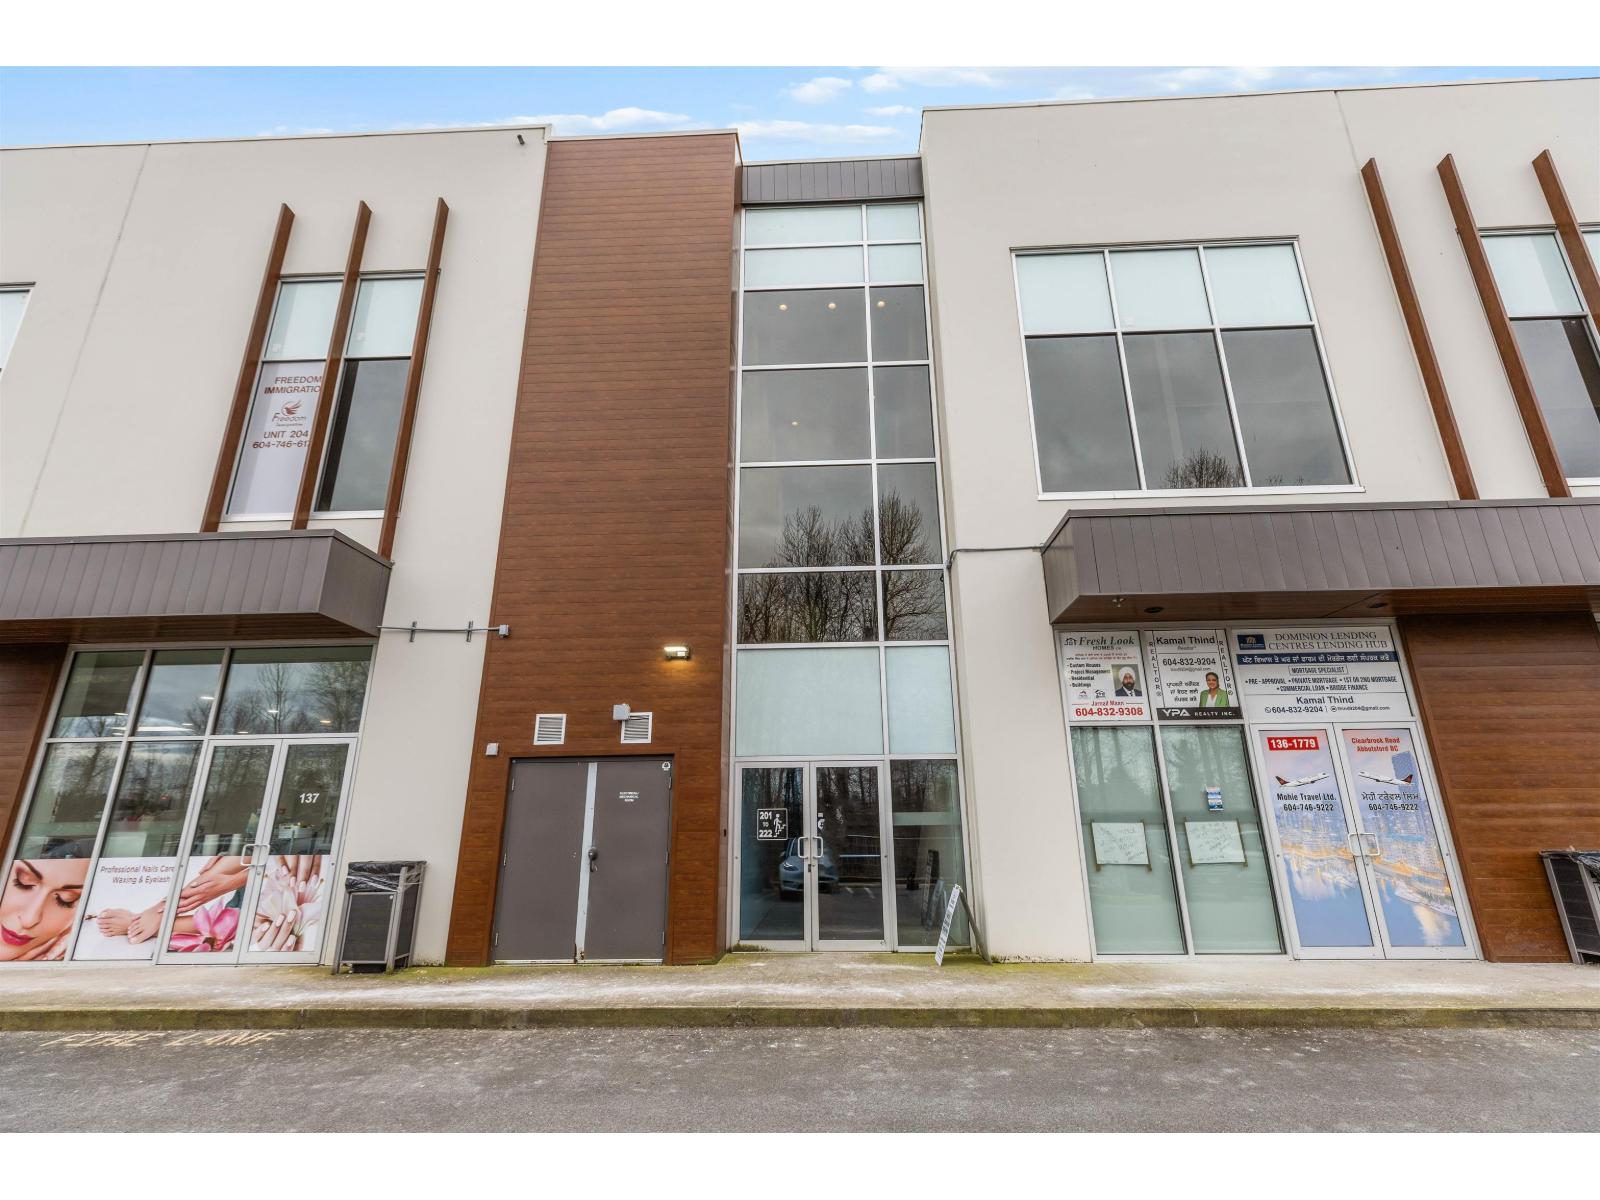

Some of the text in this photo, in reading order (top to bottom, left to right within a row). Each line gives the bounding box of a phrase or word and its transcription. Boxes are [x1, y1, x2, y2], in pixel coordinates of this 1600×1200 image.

[263, 430, 309, 439] UNIT 204
[1079, 635, 1135, 646] Fresh Look
[1156, 636, 1215, 645] Kamal Thind
[1275, 632, 1377, 641] DOMINION LENDING
[1268, 642, 1315, 650] CENTRES
[1316, 641, 1363, 649] LENDING
[1162, 658, 1216, 666] 604-832-9204
[1296, 696, 1354, 704] Kamal Thind
[1075, 707, 1144, 717] 604-832-9308
[1162, 709, 1191, 717] YPA
[1272, 706, 1324, 714] 604-832-9204
[1270, 739, 1316, 749] 136-1779
[299, 793, 320, 803] 137
[1283, 803, 1334, 811] 604-746-9222
[1368, 803, 1419, 811] 604-746-9222
[759, 811, 773, 820] 201
[758, 829, 773, 838] 222
[100, 865, 140, 874] Professional
[141, 865, 158, 873] Nails
[112, 876, 137, 885] Waxing
